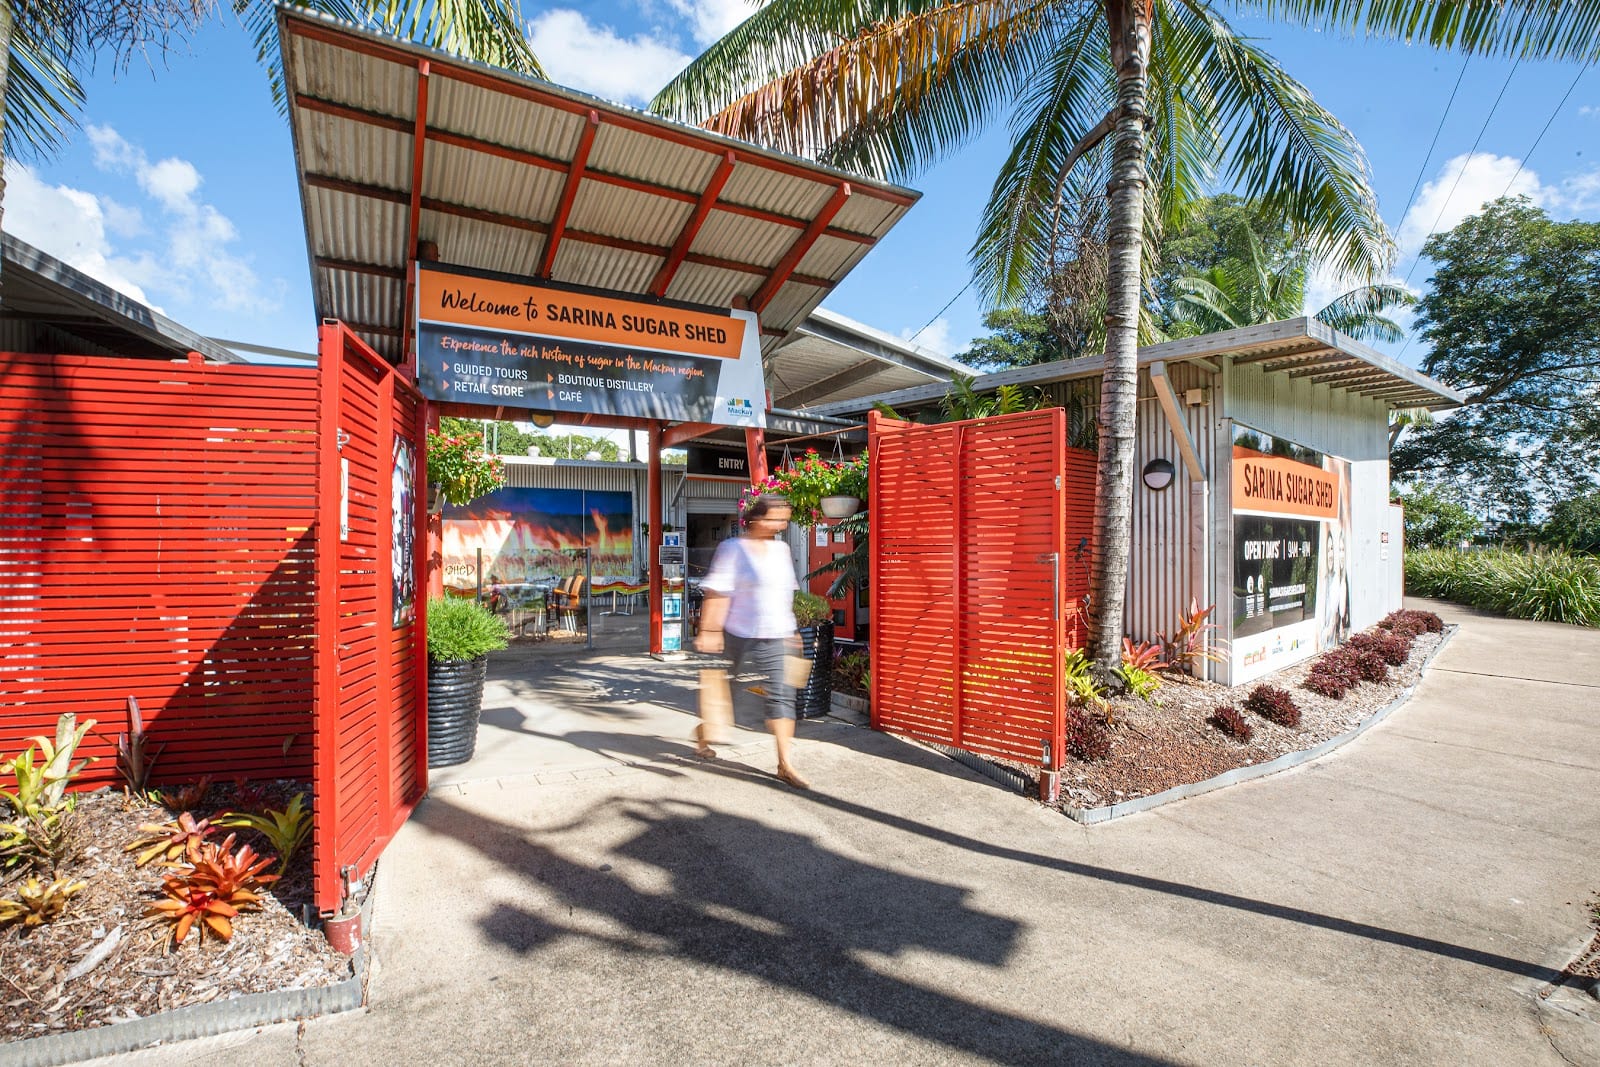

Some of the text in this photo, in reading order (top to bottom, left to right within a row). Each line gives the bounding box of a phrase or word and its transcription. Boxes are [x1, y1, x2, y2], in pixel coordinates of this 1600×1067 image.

[440, 289, 727, 344] Welcome to SARINA SUGAR SHED
[440, 336, 705, 380] Experience the rich history of sugar in the Mackay region.
[453, 363, 528, 381] GUIDED TOURS
[454, 381, 524, 397] RETAIL STORE
[558, 373, 654, 393] BOUTIQUE DISTILLERY
[559, 390, 583, 402] CAFÉ
[718, 457, 744, 470] ENTRY
[1244, 463, 1333, 509] SARINA SUGAR SHED
[1244, 540, 1261, 560] OPEN
